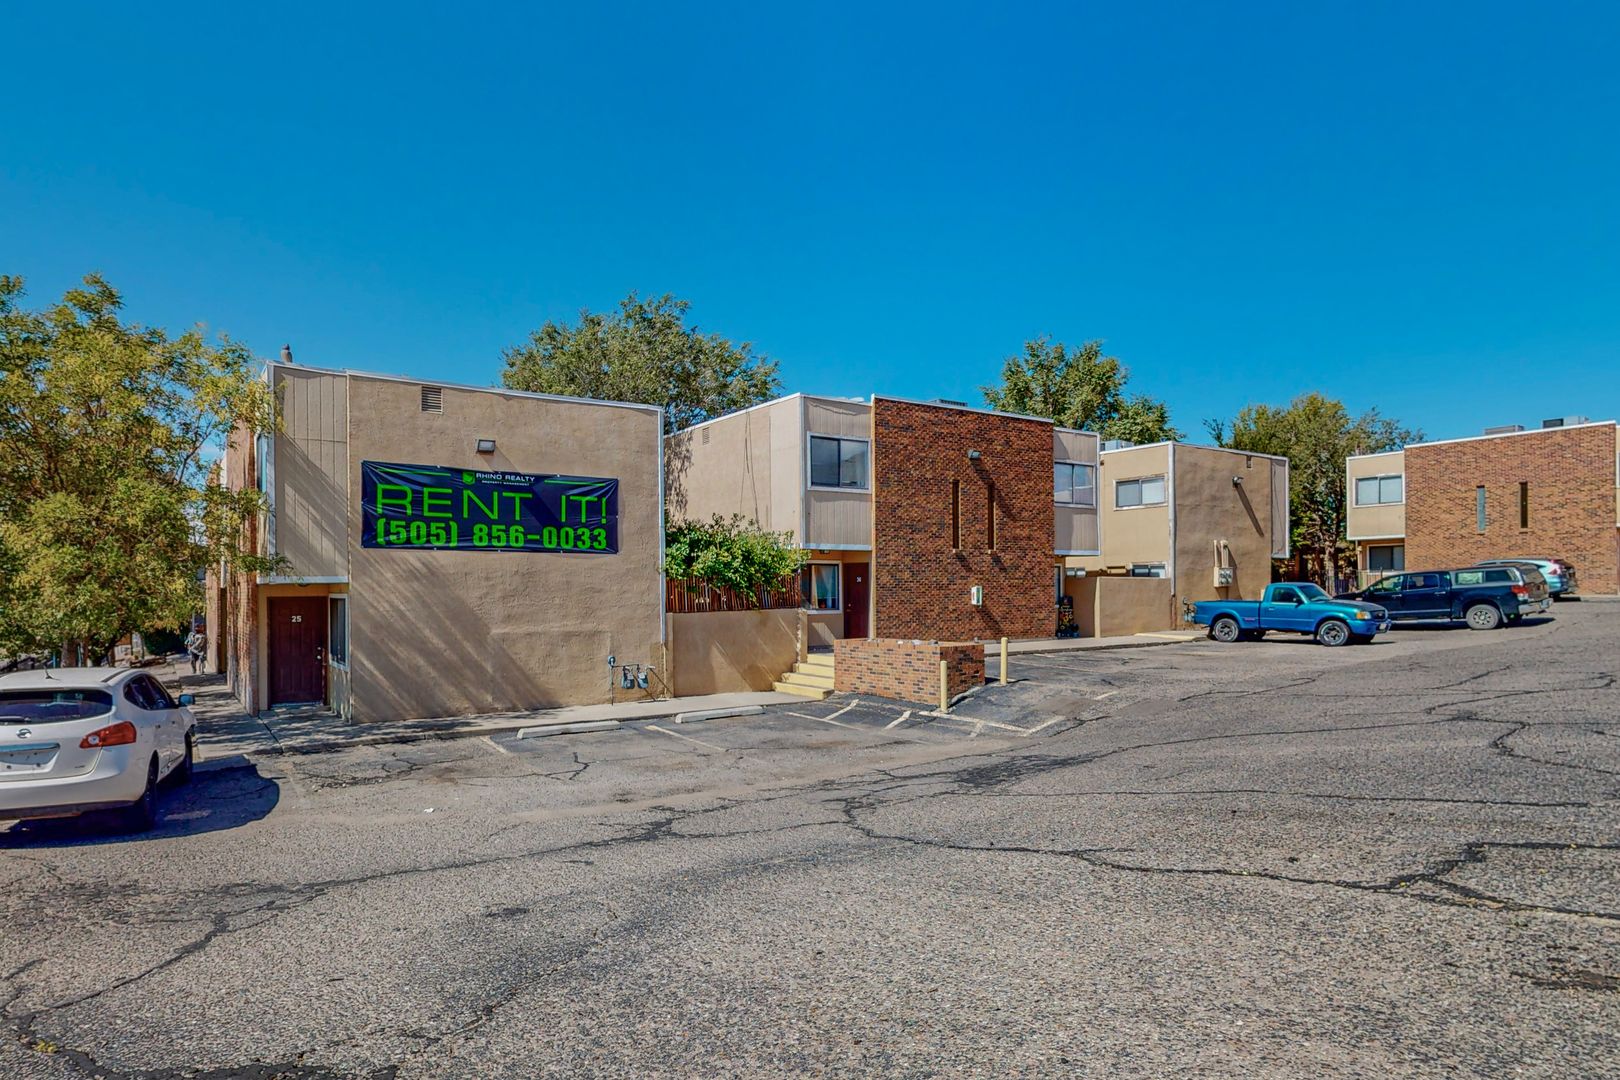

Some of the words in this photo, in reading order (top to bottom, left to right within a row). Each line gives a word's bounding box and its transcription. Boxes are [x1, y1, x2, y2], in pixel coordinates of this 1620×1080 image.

[476, 472, 502, 480] RHINO
[376, 484, 532, 521] RENT
[561, 495, 607, 525] IT!
[376, 518, 459, 547] (505)
[472, 523, 607, 550] 856-0033
[291, 615, 302, 623] 25
